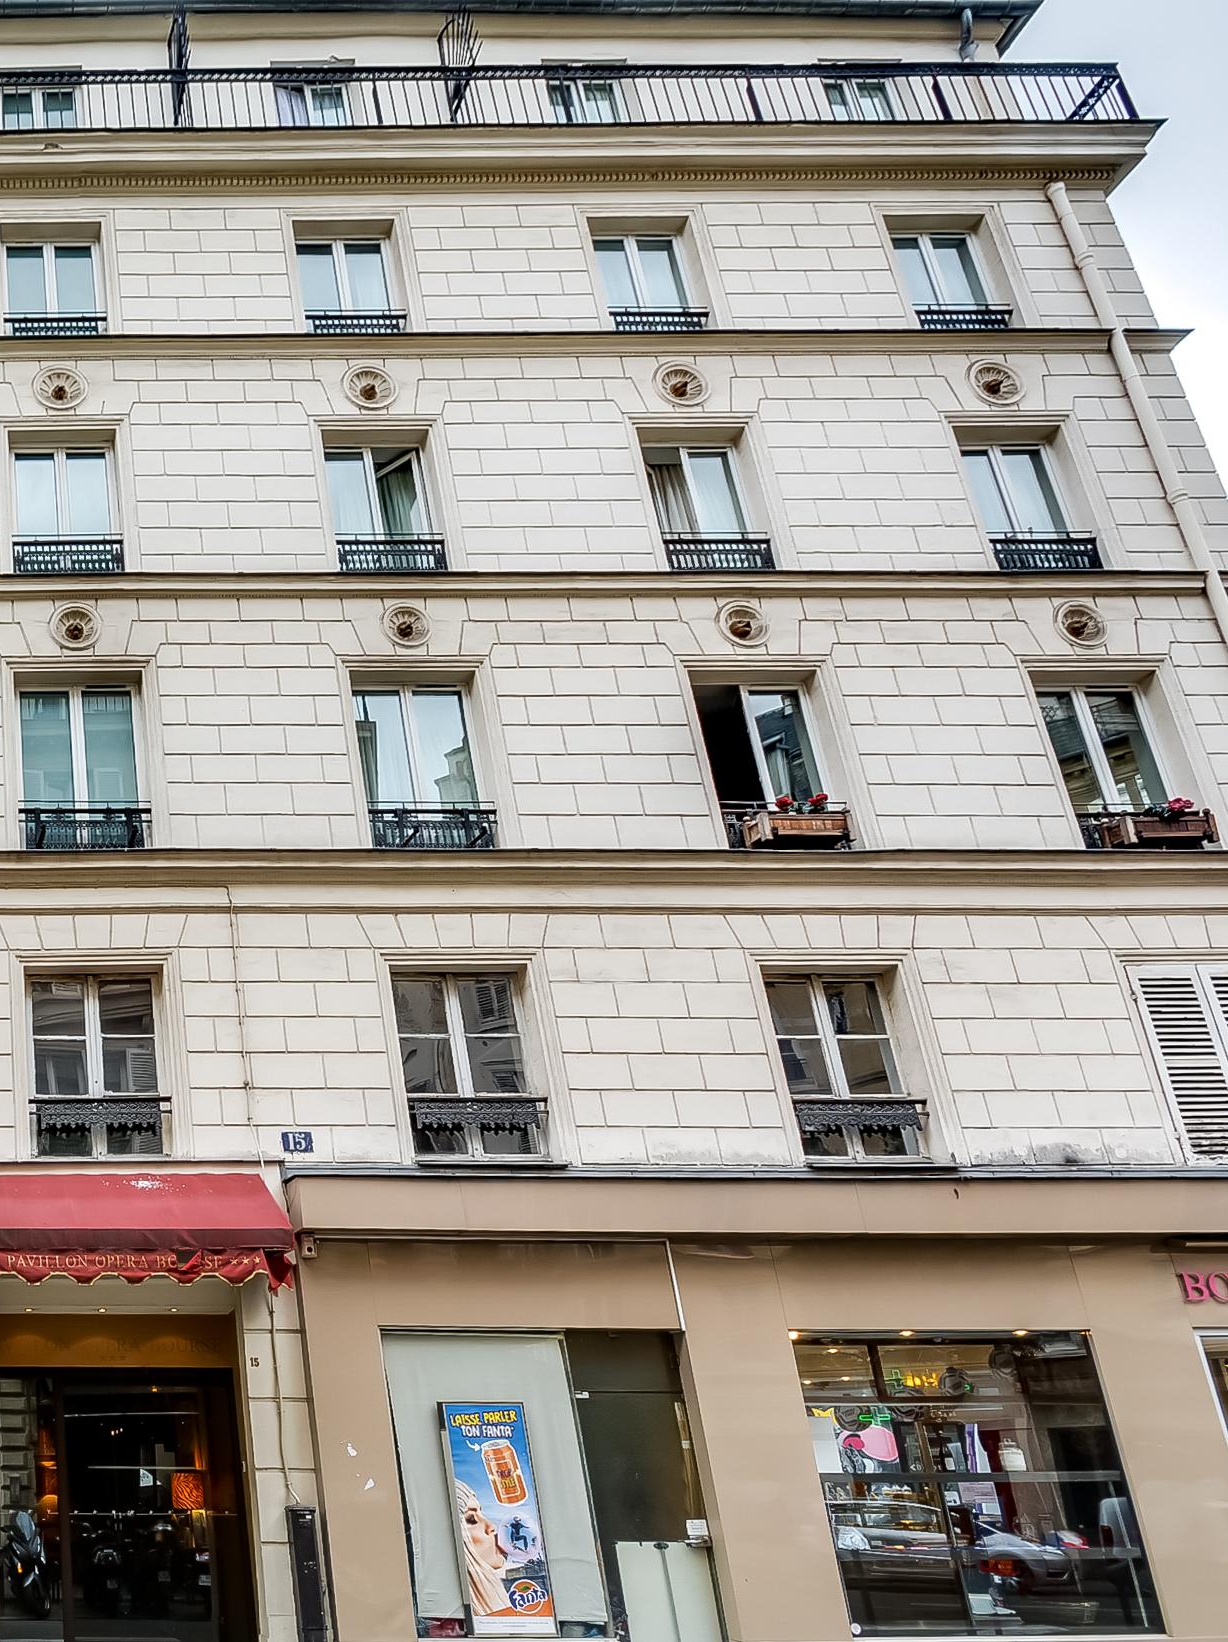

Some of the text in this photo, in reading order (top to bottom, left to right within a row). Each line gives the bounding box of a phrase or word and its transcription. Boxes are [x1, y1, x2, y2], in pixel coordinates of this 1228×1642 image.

[287, 1133, 306, 1150] 15
[7, 1254, 88, 1269] PAVILLON
[95, 1254, 148, 1269] OPERA
[249, 1356, 260, 1368] 15
[450, 1410, 517, 1426] LAISSE PARLER
[461, 1425, 480, 1437] TON
[508, 1587, 547, 1610] Fanta
